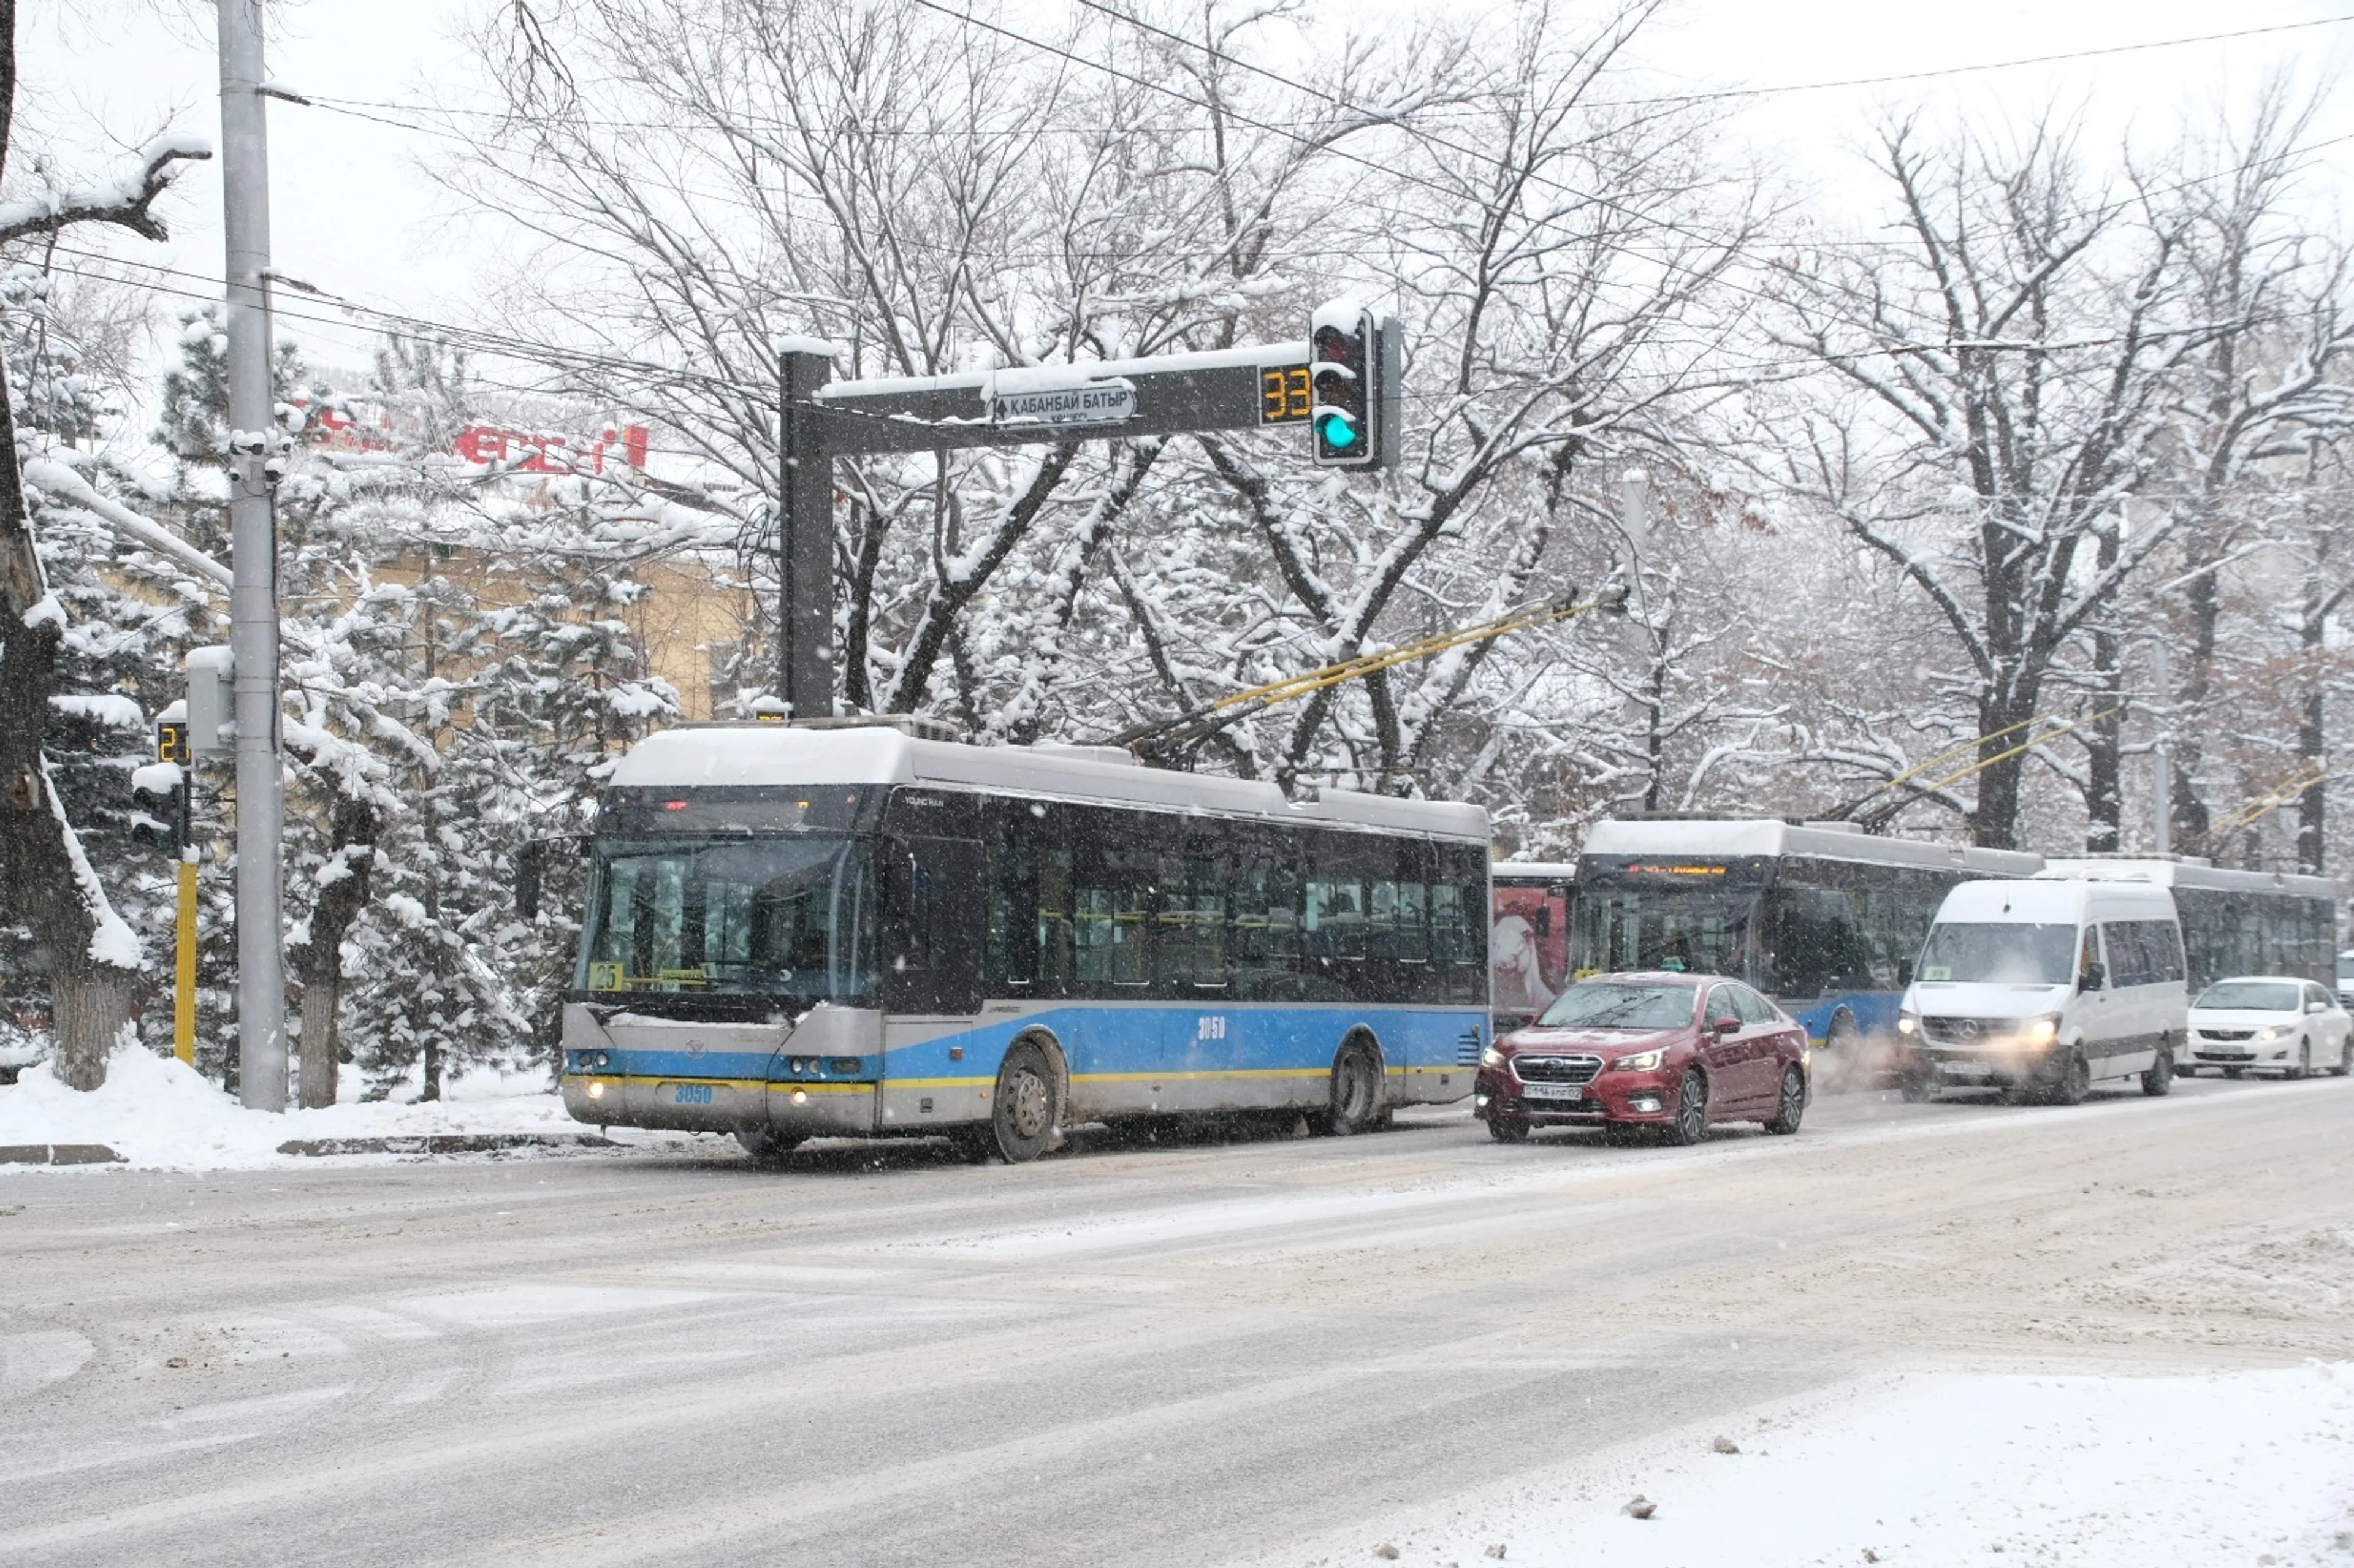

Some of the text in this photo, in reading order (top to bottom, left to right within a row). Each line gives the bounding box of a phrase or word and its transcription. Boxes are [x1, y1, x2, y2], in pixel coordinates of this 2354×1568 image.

[1011, 391, 1128, 415] ҚАБАНБАЙ БАТЫР
[1265, 370, 1311, 417] 33
[596, 965, 616, 989] 25
[1198, 1016, 1225, 1040] 3050
[676, 1084, 712, 1104] 3050
